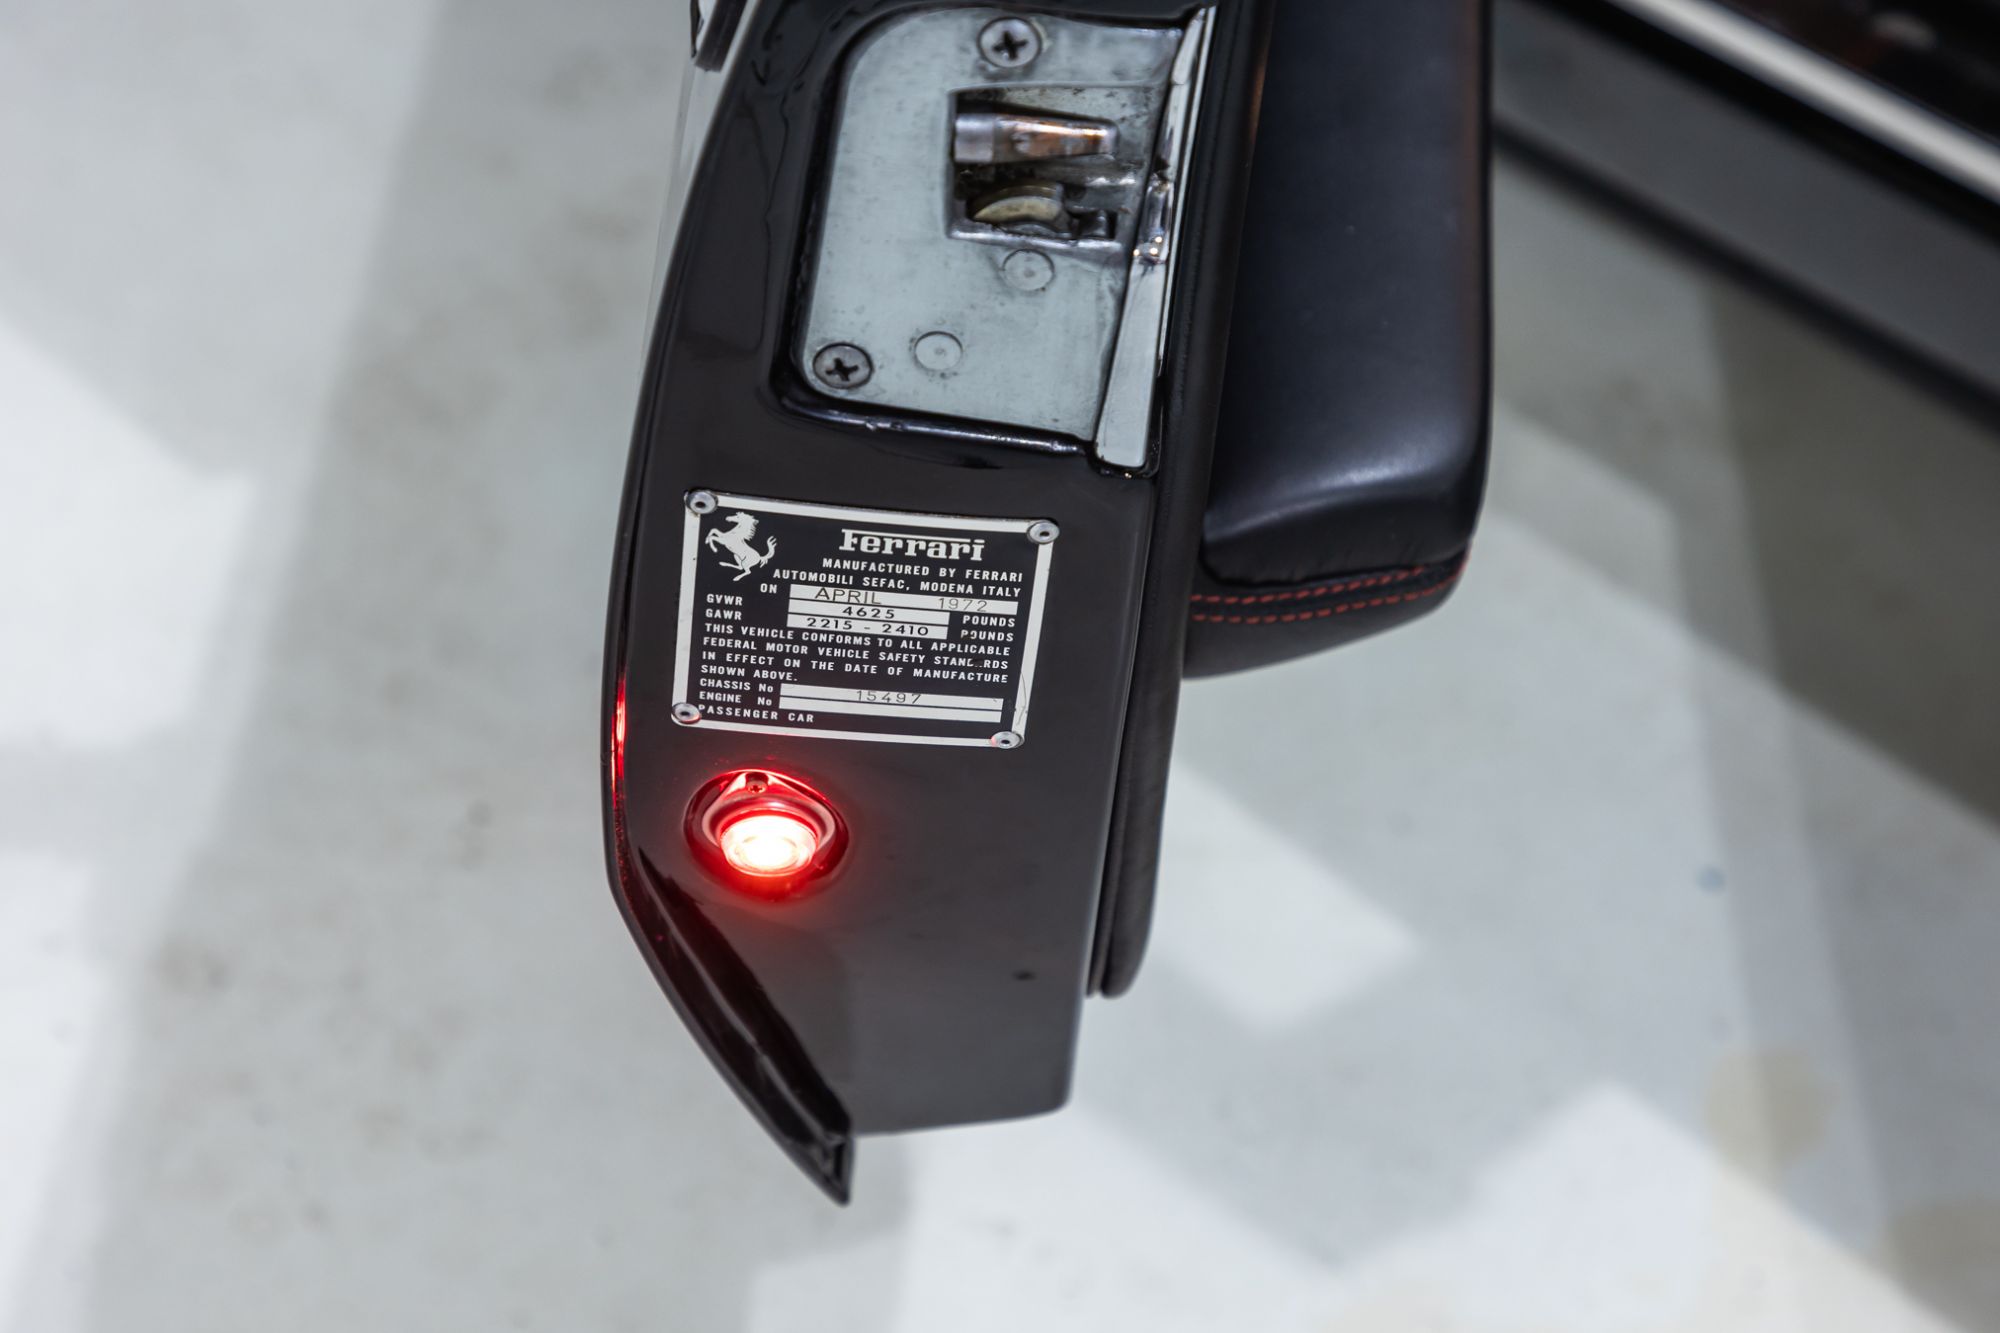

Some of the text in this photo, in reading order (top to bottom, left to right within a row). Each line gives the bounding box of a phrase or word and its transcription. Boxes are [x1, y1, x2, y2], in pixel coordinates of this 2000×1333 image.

[839, 528, 985, 561] Ferrari
[773, 568, 1021, 597] AUTOMOBILI SEFAC, MODENA ITALY
[823, 557, 1023, 582] MANUFACTURED BY FERRARI
[706, 593, 1015, 627] GVWR 4625 POUNDS
[760, 583, 988, 612] ON APRIL 1972
[704, 622, 1010, 656] THIS VEHICLE CONFORMS TO ALL APPLICABLE
[705, 609, 742, 621] GAWR
[807, 617, 852, 630] 2215
[882, 623, 929, 636] 2410
[960, 629, 1014, 642] POUNDS
[702, 651, 1009, 683] IN EFFECT ON THE DATE OF MANUFACTURE
[703, 637, 1008, 669] FEDERAL MOTOR VEHICLE SAFETY STANDRDS
[701, 664, 798, 681] SHOWN ABOVE.
[699, 691, 742, 703] ENGINE
[700, 678, 751, 691] CHASSIS
[856, 689, 922, 704] 15497
[698, 704, 814, 723] PASSENGER CAR
